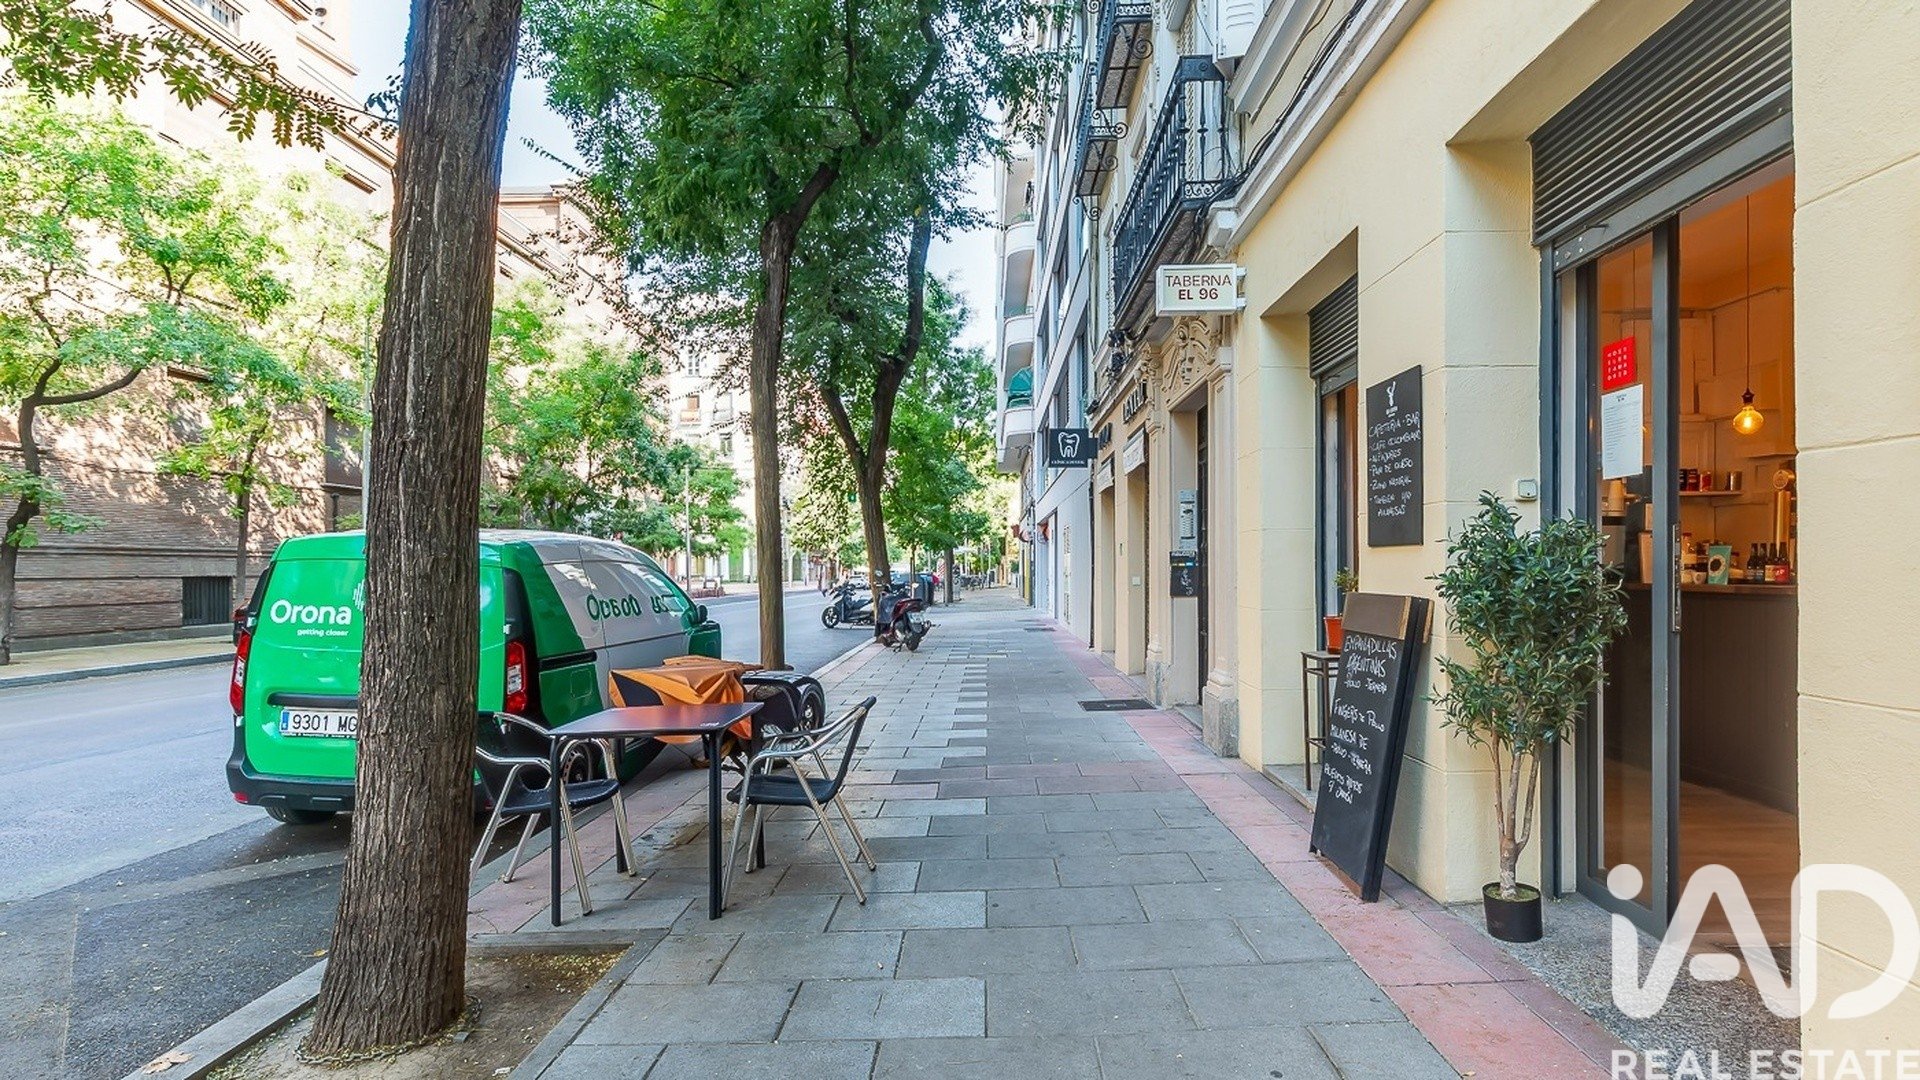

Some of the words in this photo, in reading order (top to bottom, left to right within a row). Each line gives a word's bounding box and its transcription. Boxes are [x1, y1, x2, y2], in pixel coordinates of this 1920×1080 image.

[1165, 275, 1232, 287] TABERNA
[1178, 289, 1193, 300] EL
[1199, 288, 1219, 300] 96
[270, 599, 352, 625] Orona
[297, 628, 324, 637] getting
[325, 628, 349, 636] closer
[292, 714, 329, 731] 9301
[337, 716, 358, 732] MG
